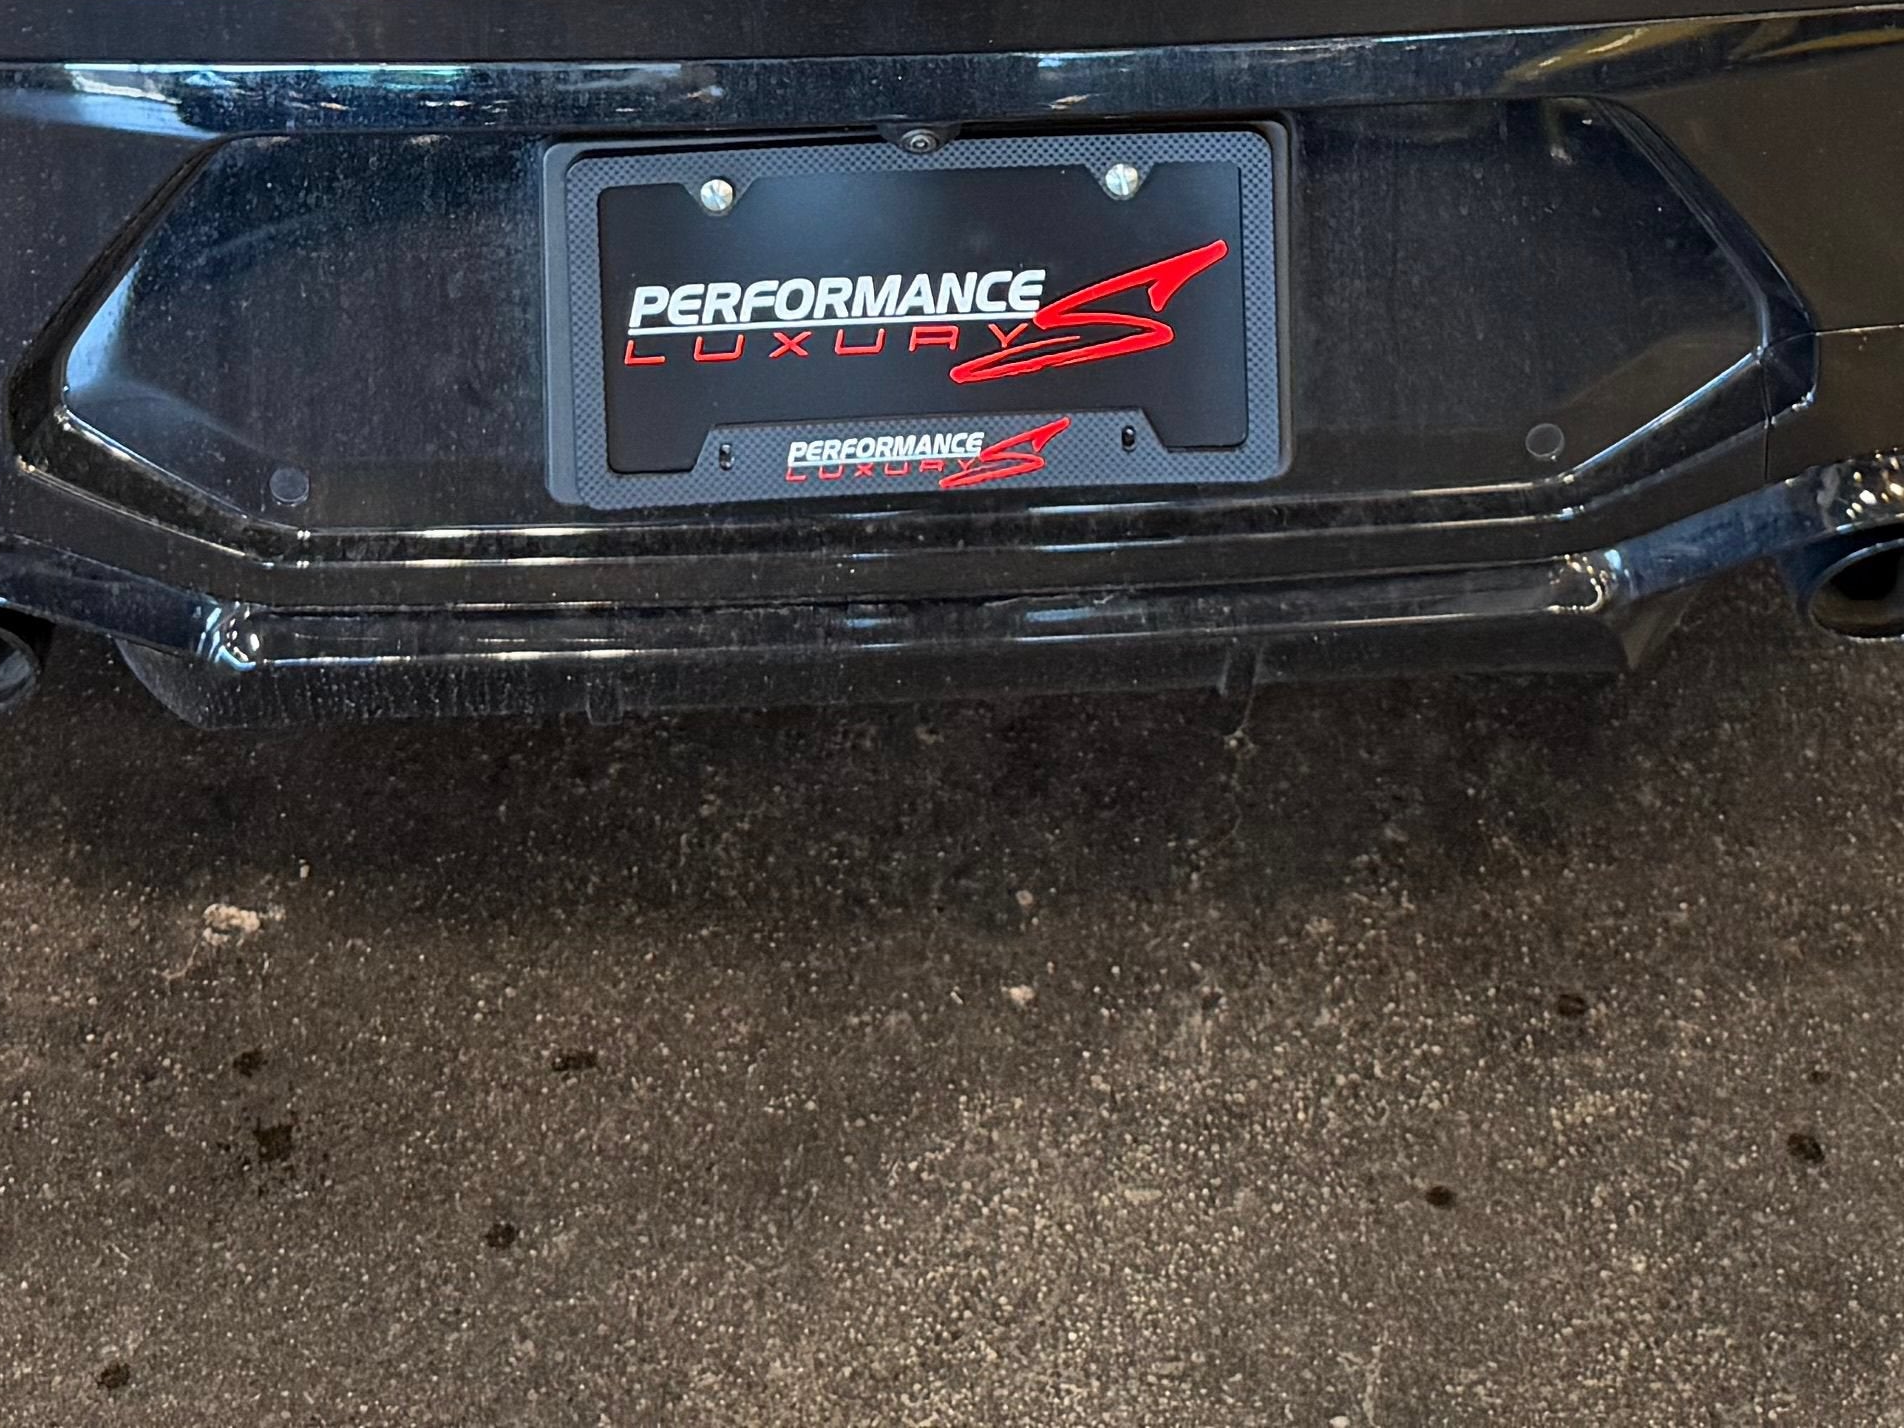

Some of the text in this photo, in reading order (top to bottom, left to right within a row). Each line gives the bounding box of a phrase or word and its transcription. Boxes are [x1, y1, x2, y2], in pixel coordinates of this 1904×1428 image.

[629, 269, 1046, 328] PERFORMANCE
[625, 322, 1028, 365] LUXURY
[788, 431, 985, 462] PERFORMANCE
[785, 458, 975, 482] LUXURY
